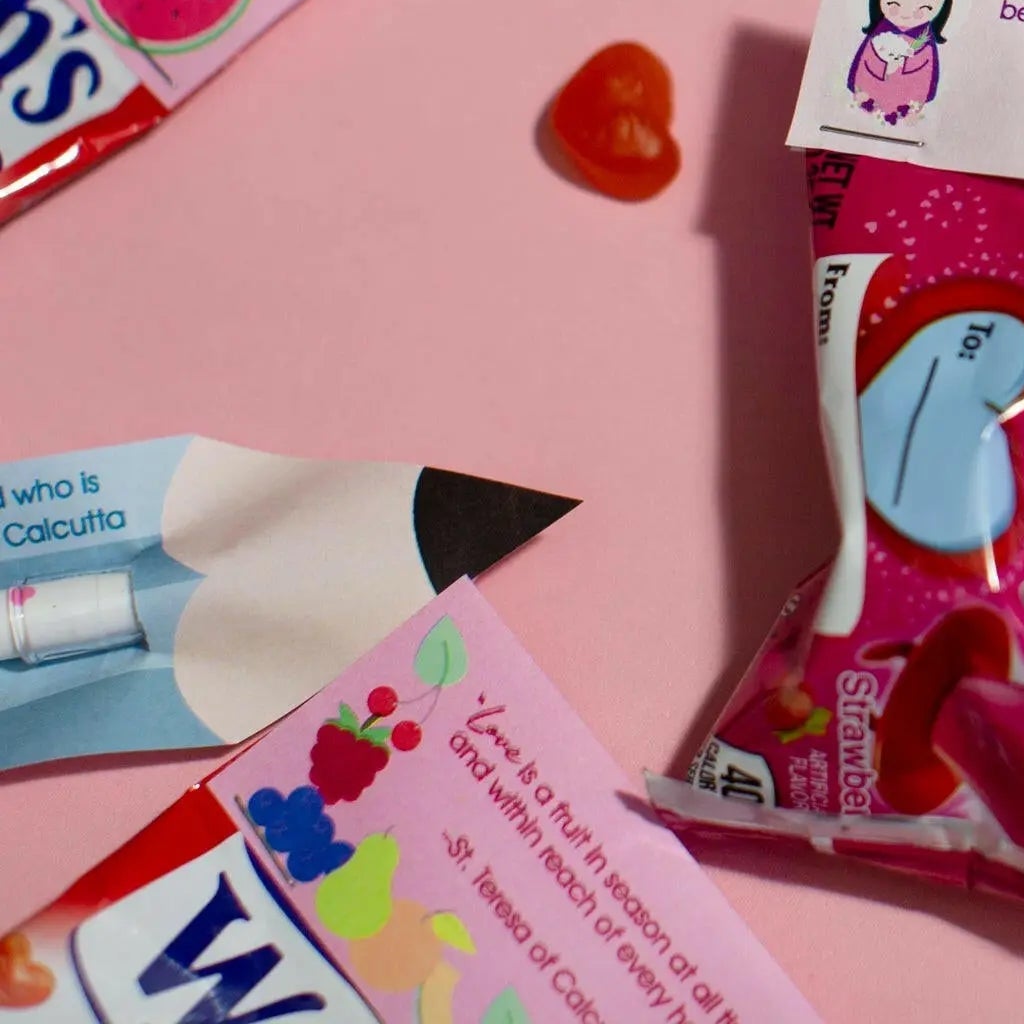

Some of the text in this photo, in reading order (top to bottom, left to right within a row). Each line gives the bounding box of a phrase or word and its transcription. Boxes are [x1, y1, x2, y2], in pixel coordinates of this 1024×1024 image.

[957, 321, 996, 360] To:
[11, 478, 74, 507] who
[80, 471, 101, 495] is
[3, 508, 127, 548] Calcutta
[449, 730, 496, 782] and
[488, 777, 544, 849] within
[538, 844, 599, 919] reach
[594, 915, 627, 942] of
[616, 941, 674, 1008] every
[517, 759, 538, 785] is
[534, 785, 554, 806] a
[549, 801, 592, 849] fruit
[584, 842, 608, 875] in
[603, 870, 673, 955] season
[668, 953, 699, 983] at
[692, 982, 725, 1014] all
[470, 865, 533, 946] Teresa
[529, 942, 561, 971] of
